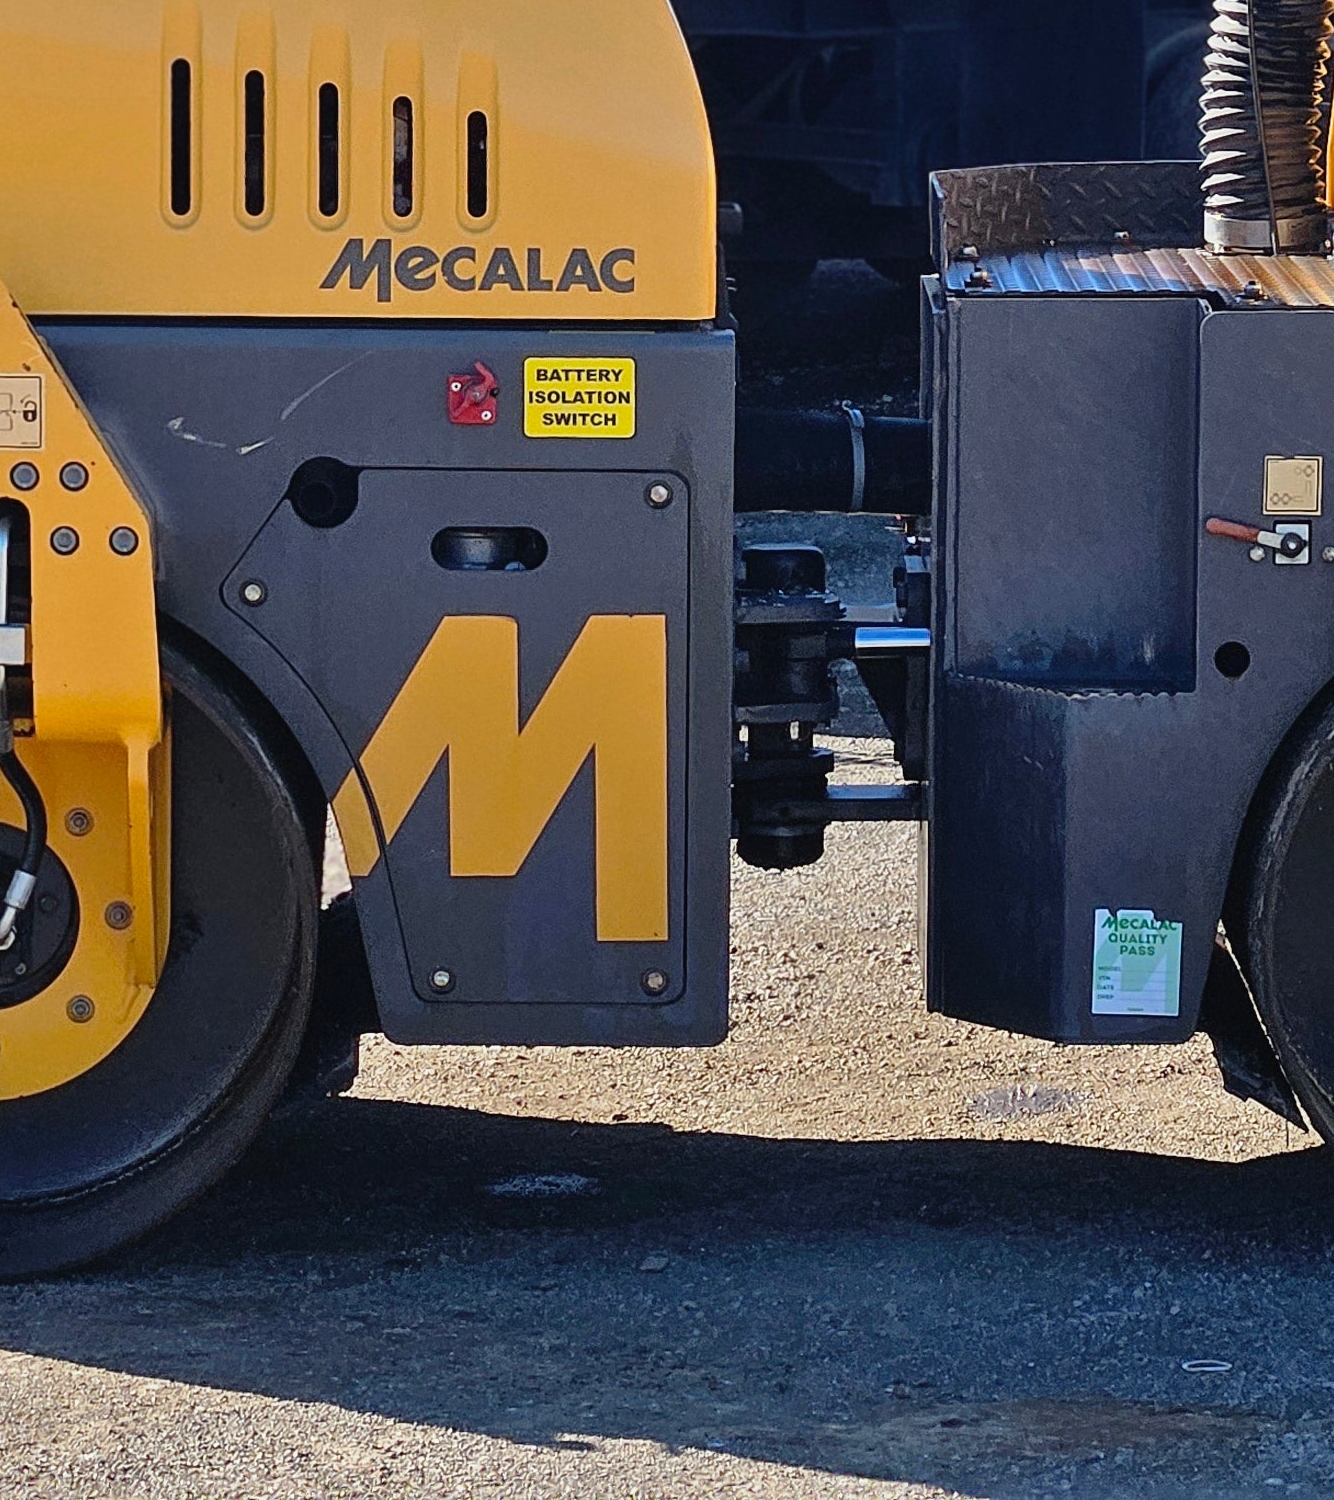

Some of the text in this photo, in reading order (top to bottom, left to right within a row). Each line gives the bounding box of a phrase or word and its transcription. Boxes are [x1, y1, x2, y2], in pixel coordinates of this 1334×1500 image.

[535, 367, 623, 382] BATTERY
[528, 390, 631, 405] ISOLATION
[542, 411, 617, 427] SWITCH
[1108, 932, 1168, 945] QUALITY
[1119, 945, 1155, 956] PASS
